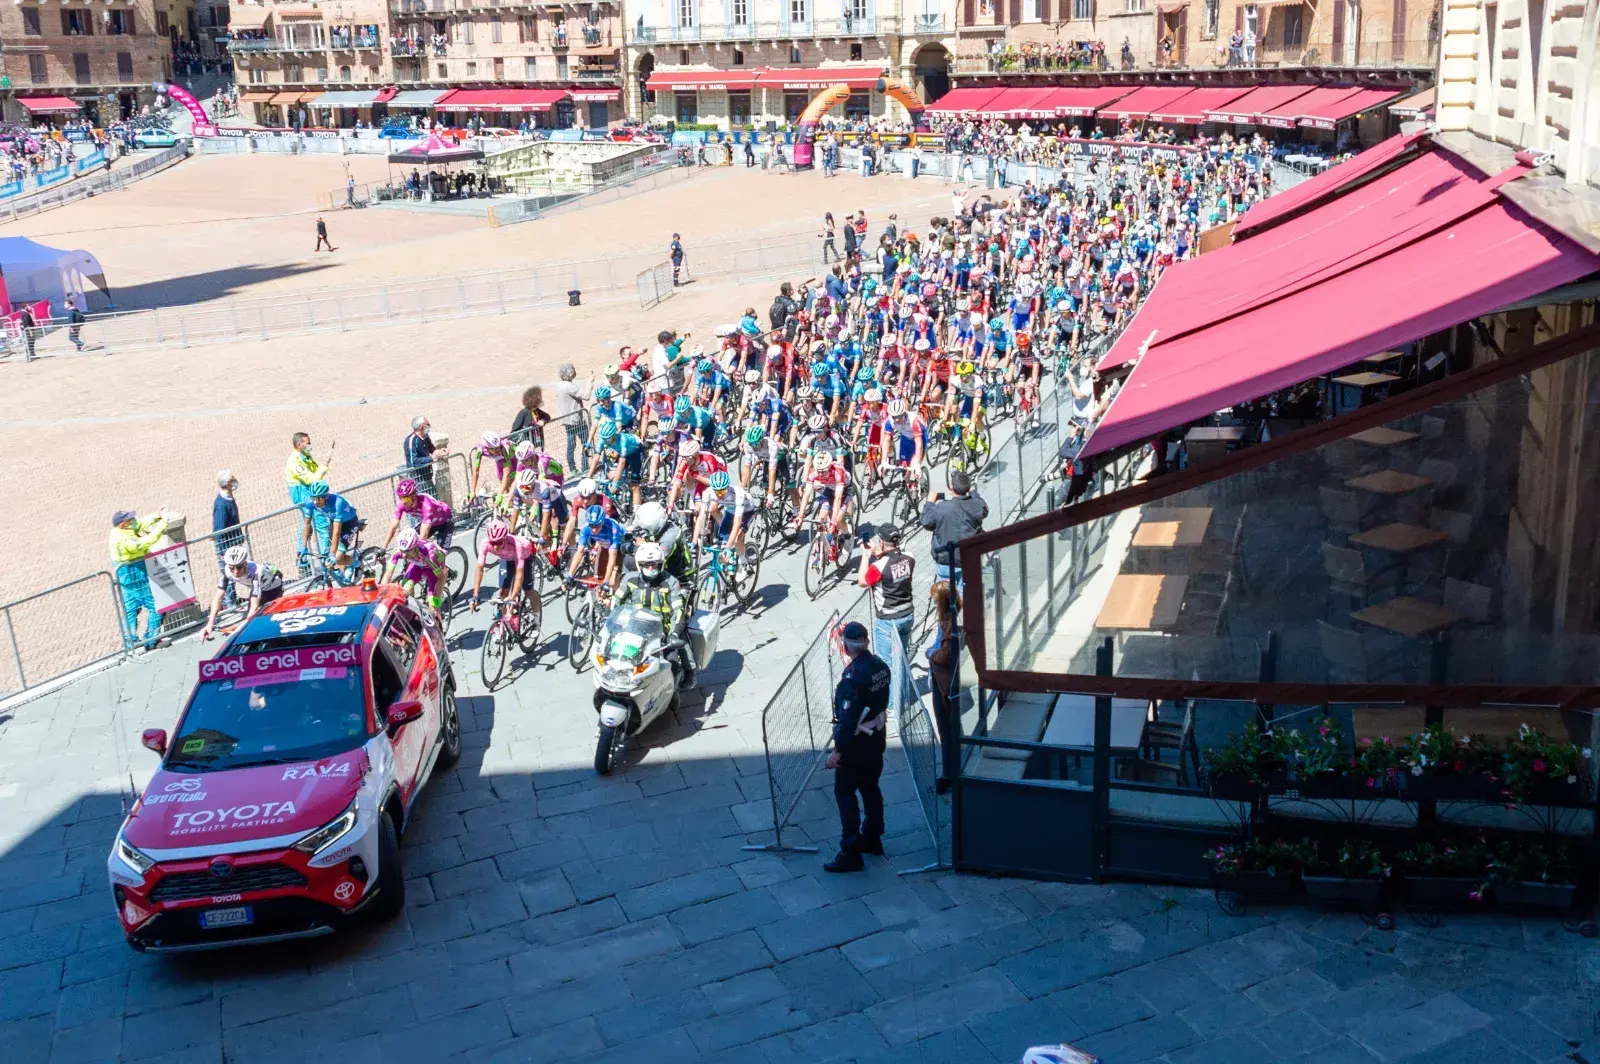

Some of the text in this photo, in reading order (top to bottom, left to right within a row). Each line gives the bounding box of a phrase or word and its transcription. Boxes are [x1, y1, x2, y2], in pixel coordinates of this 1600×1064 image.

[218, 128, 243, 137] TOYOTA
[249, 130, 274, 138] TOYOTA
[312, 131, 337, 139] TOYOTA
[891, 564, 911, 580] VISA
[202, 646, 357, 677] enel enel enel
[282, 762, 350, 781] RAV4
[173, 801, 297, 828] TOYOTA
[170, 817, 285, 836] MOBILITY PARTNER
[320, 847, 353, 864] TOYOTA
[112, 872, 135, 886] TOYOTA
[211, 893, 242, 904] TOYOTA
